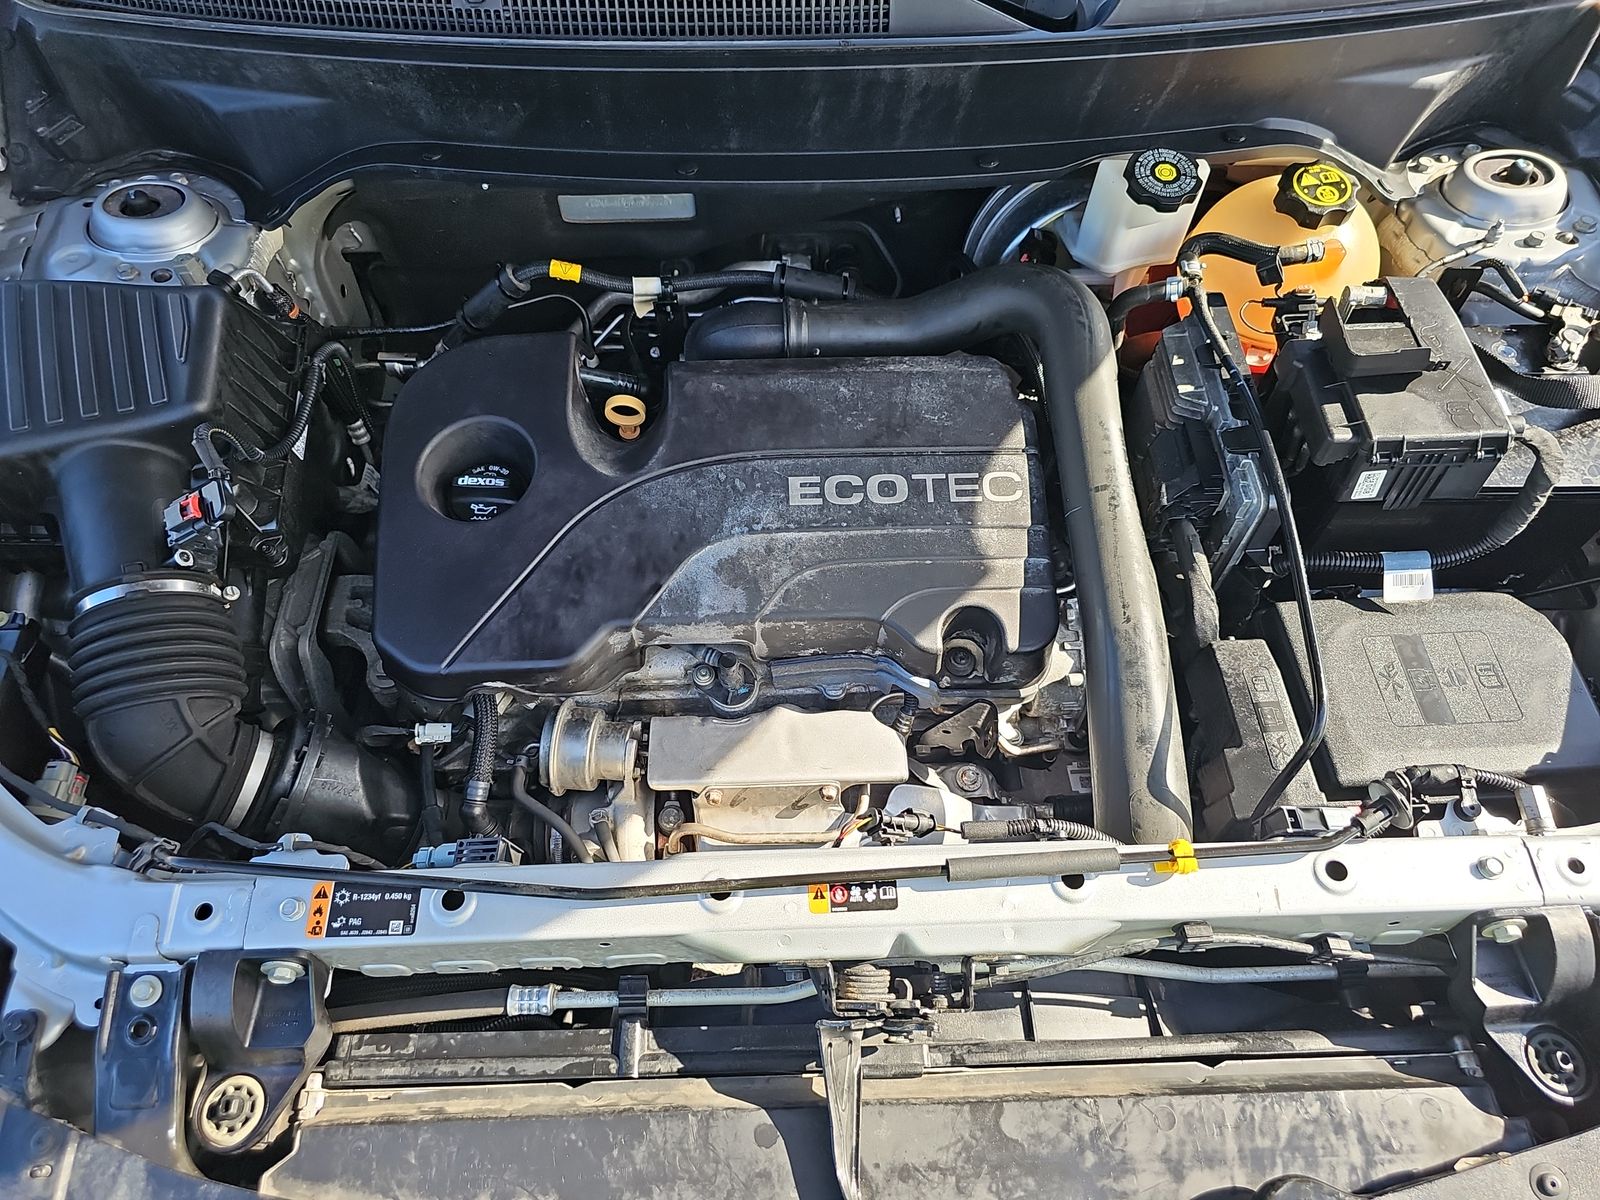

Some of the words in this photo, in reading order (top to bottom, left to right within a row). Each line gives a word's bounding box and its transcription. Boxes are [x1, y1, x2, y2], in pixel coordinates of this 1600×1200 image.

[472, 466, 485, 474] SAE
[488, 465, 510, 475] 0W-20
[457, 475, 506, 486] dexos
[788, 471, 1023, 506] ECOTEC
[352, 893, 381, 901] R-1234yf
[403, 892, 412, 901] kg
[348, 918, 362, 926] PAG
